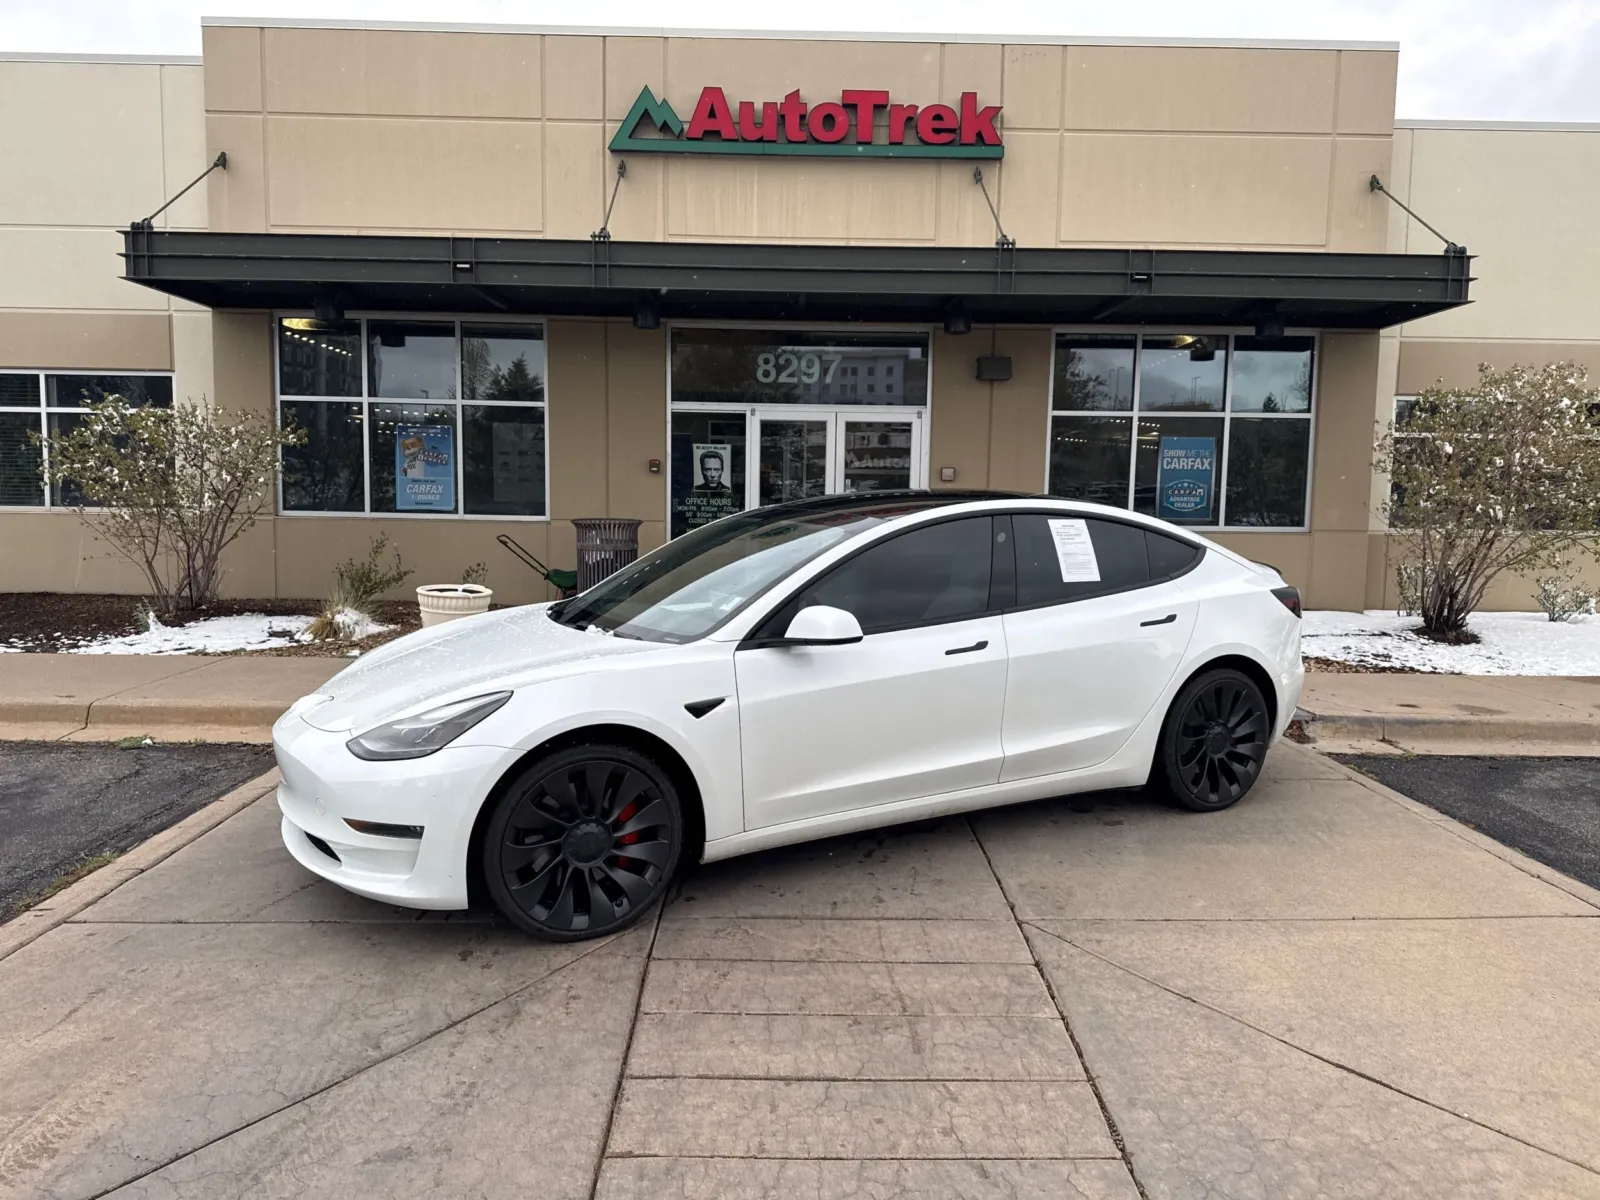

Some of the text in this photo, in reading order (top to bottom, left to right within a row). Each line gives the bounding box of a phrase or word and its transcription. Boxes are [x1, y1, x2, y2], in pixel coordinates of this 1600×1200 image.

[686, 86, 1003, 145] AutoTrek
[756, 353, 842, 384] 8297
[1163, 449, 1186, 457] SHOW
[1163, 458, 1211, 470] CARFAX
[406, 484, 444, 494] CARFAX
[710, 498, 732, 506] HOURS
